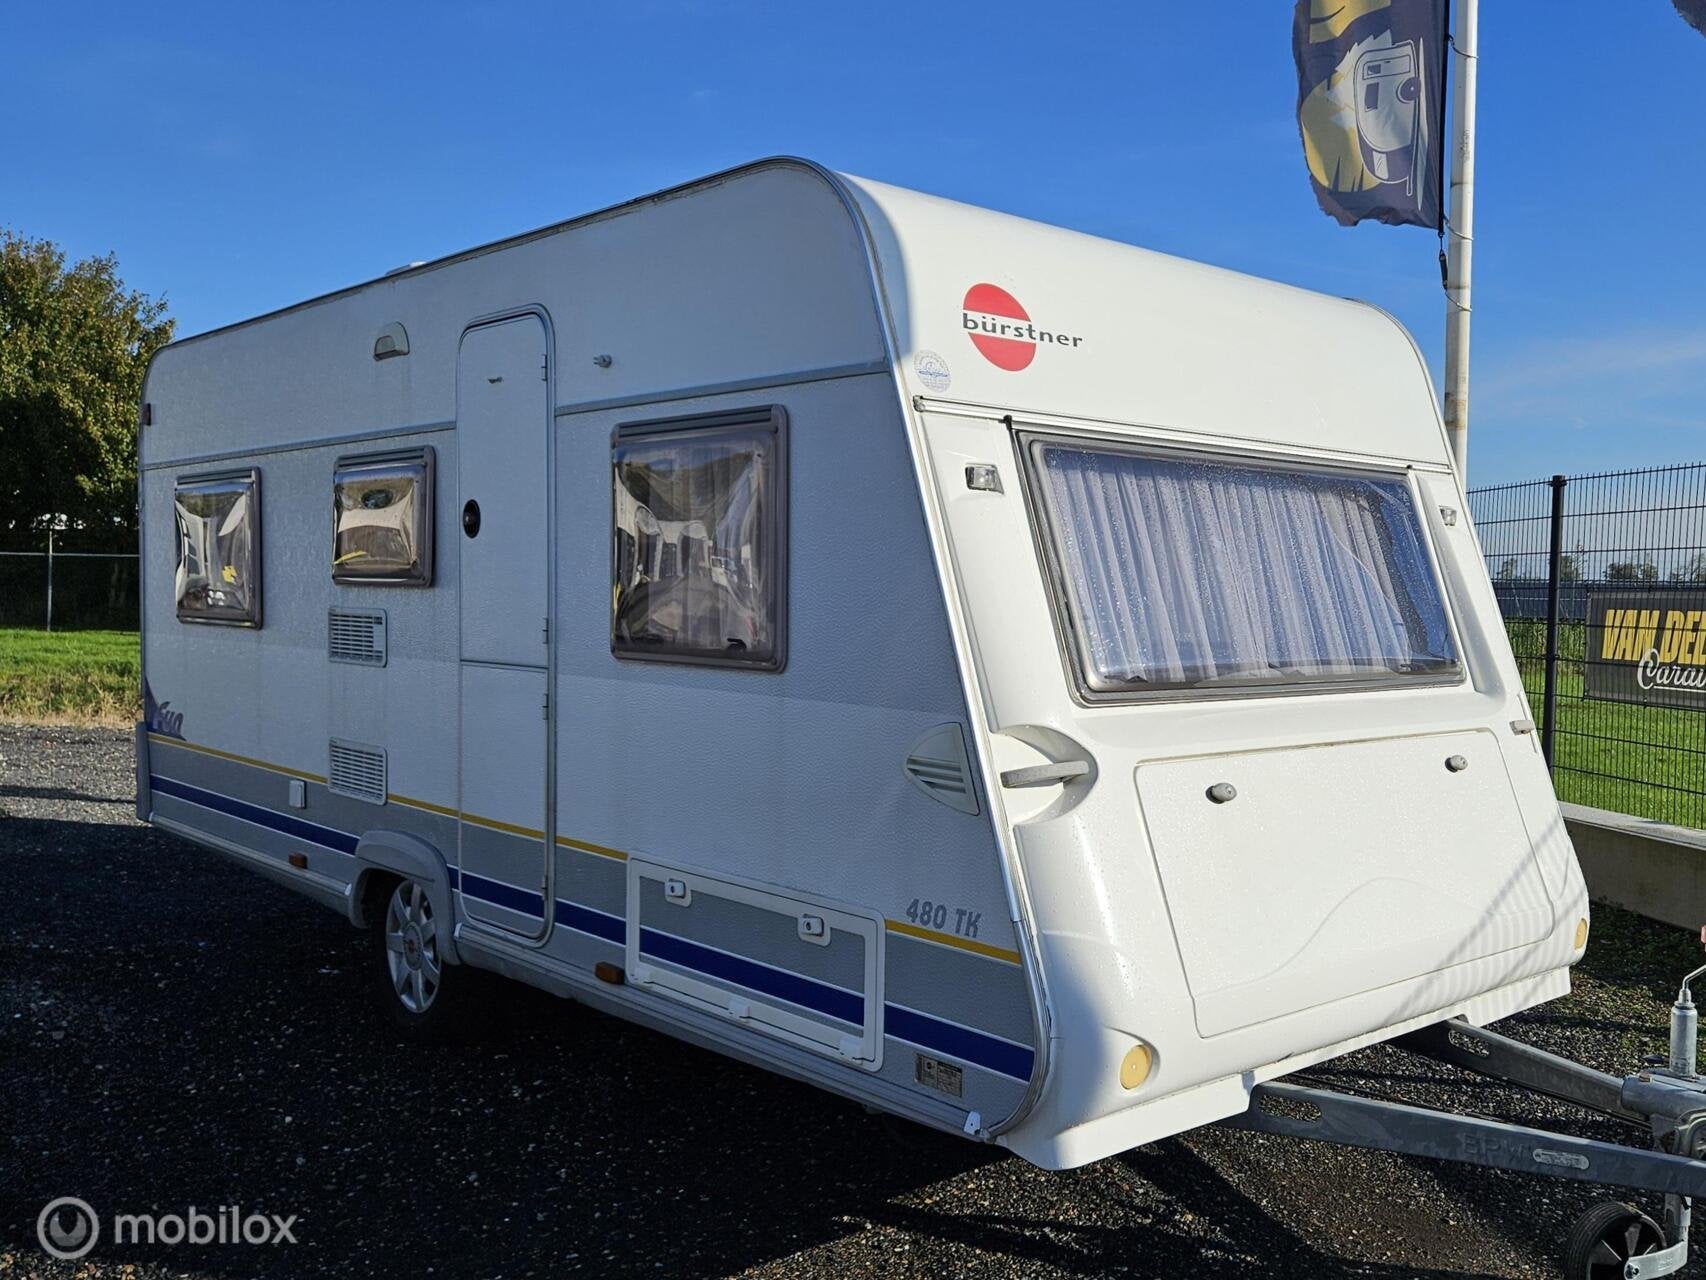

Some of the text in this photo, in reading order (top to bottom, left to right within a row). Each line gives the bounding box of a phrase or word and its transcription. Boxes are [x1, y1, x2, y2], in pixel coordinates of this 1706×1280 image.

[962, 312, 1083, 347] bürstner
[1601, 609, 1660, 661] VAN
[906, 898, 982, 938] 480 TK
